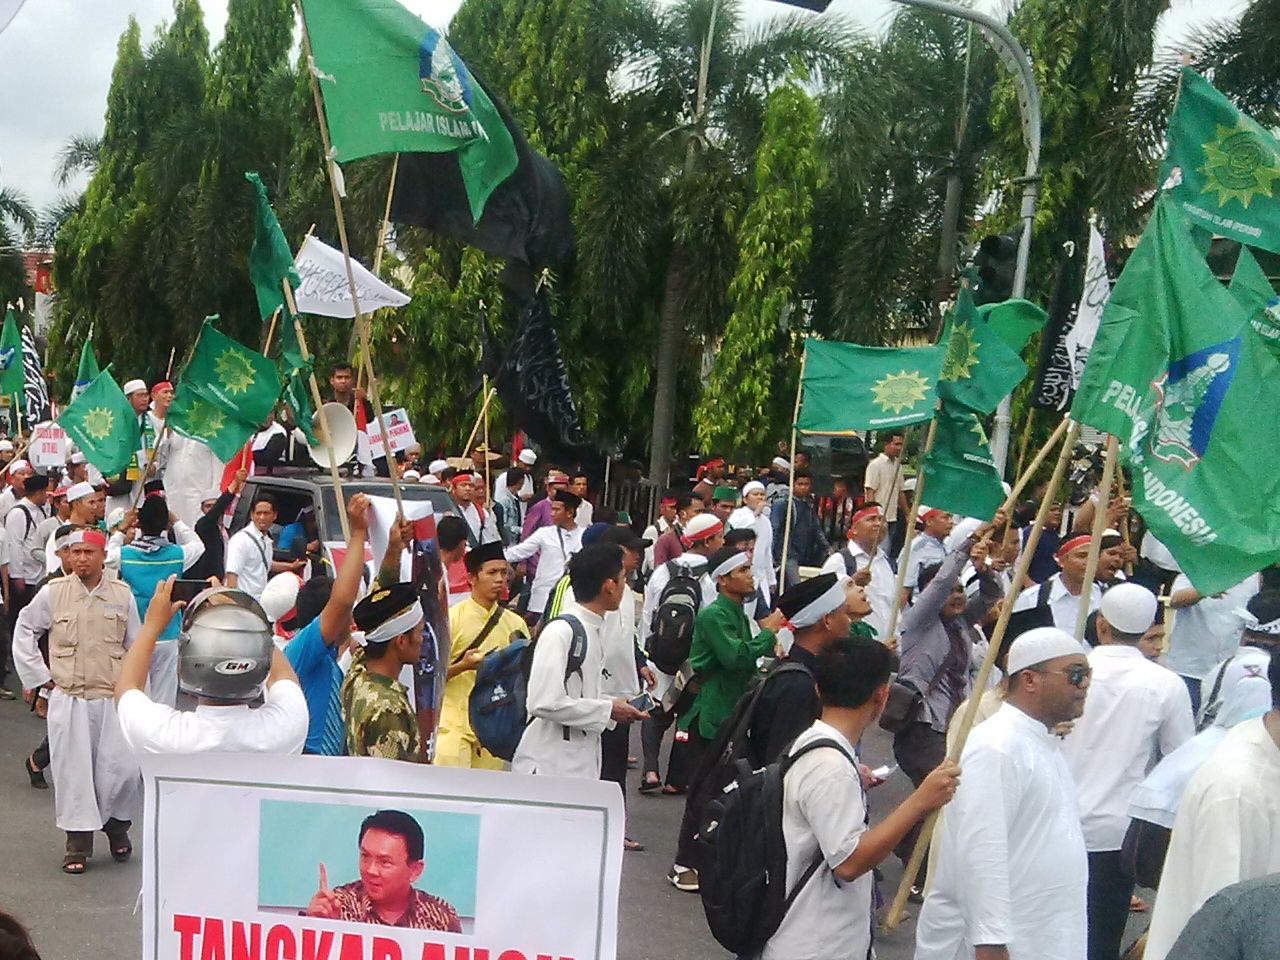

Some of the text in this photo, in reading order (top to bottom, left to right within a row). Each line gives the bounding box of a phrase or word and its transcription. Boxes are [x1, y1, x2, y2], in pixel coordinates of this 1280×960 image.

[379, 111, 435, 132] PELAJAR
[1143, 466, 1218, 546] NDONESIA
[225, 662, 249, 671] GM
